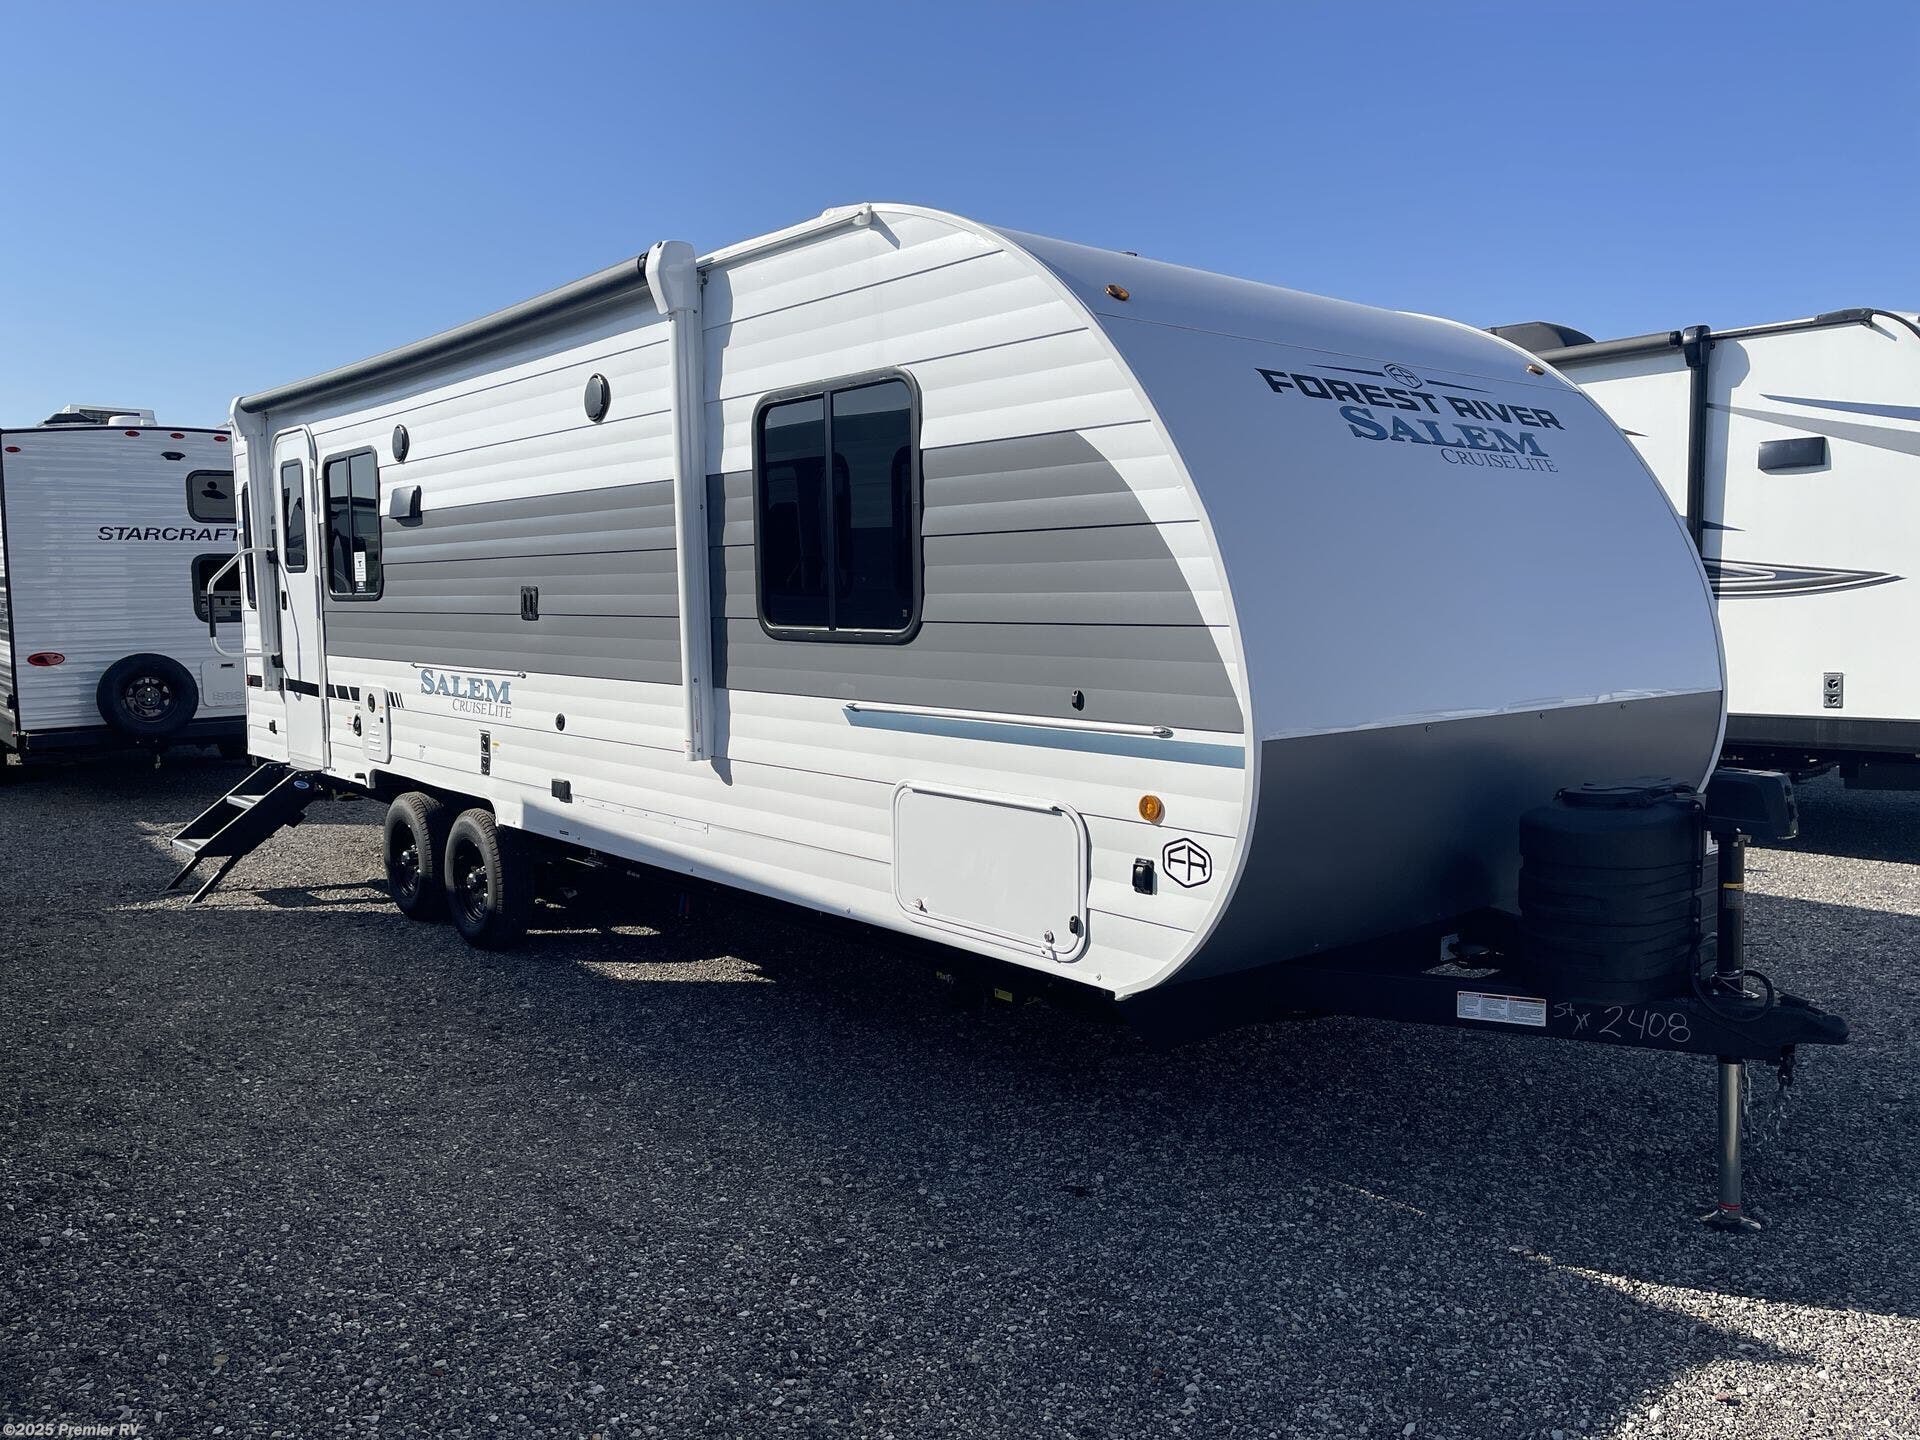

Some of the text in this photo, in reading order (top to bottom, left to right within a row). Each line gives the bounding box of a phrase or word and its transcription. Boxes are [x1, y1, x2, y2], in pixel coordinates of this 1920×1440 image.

[1254, 367, 1567, 431] FOREST RIVER
[1338, 405, 1550, 457] SALEM
[97, 526, 238, 541] STARCRAFT
[420, 668, 512, 705] SALEM
[1599, 1005, 1692, 1042] 2408
